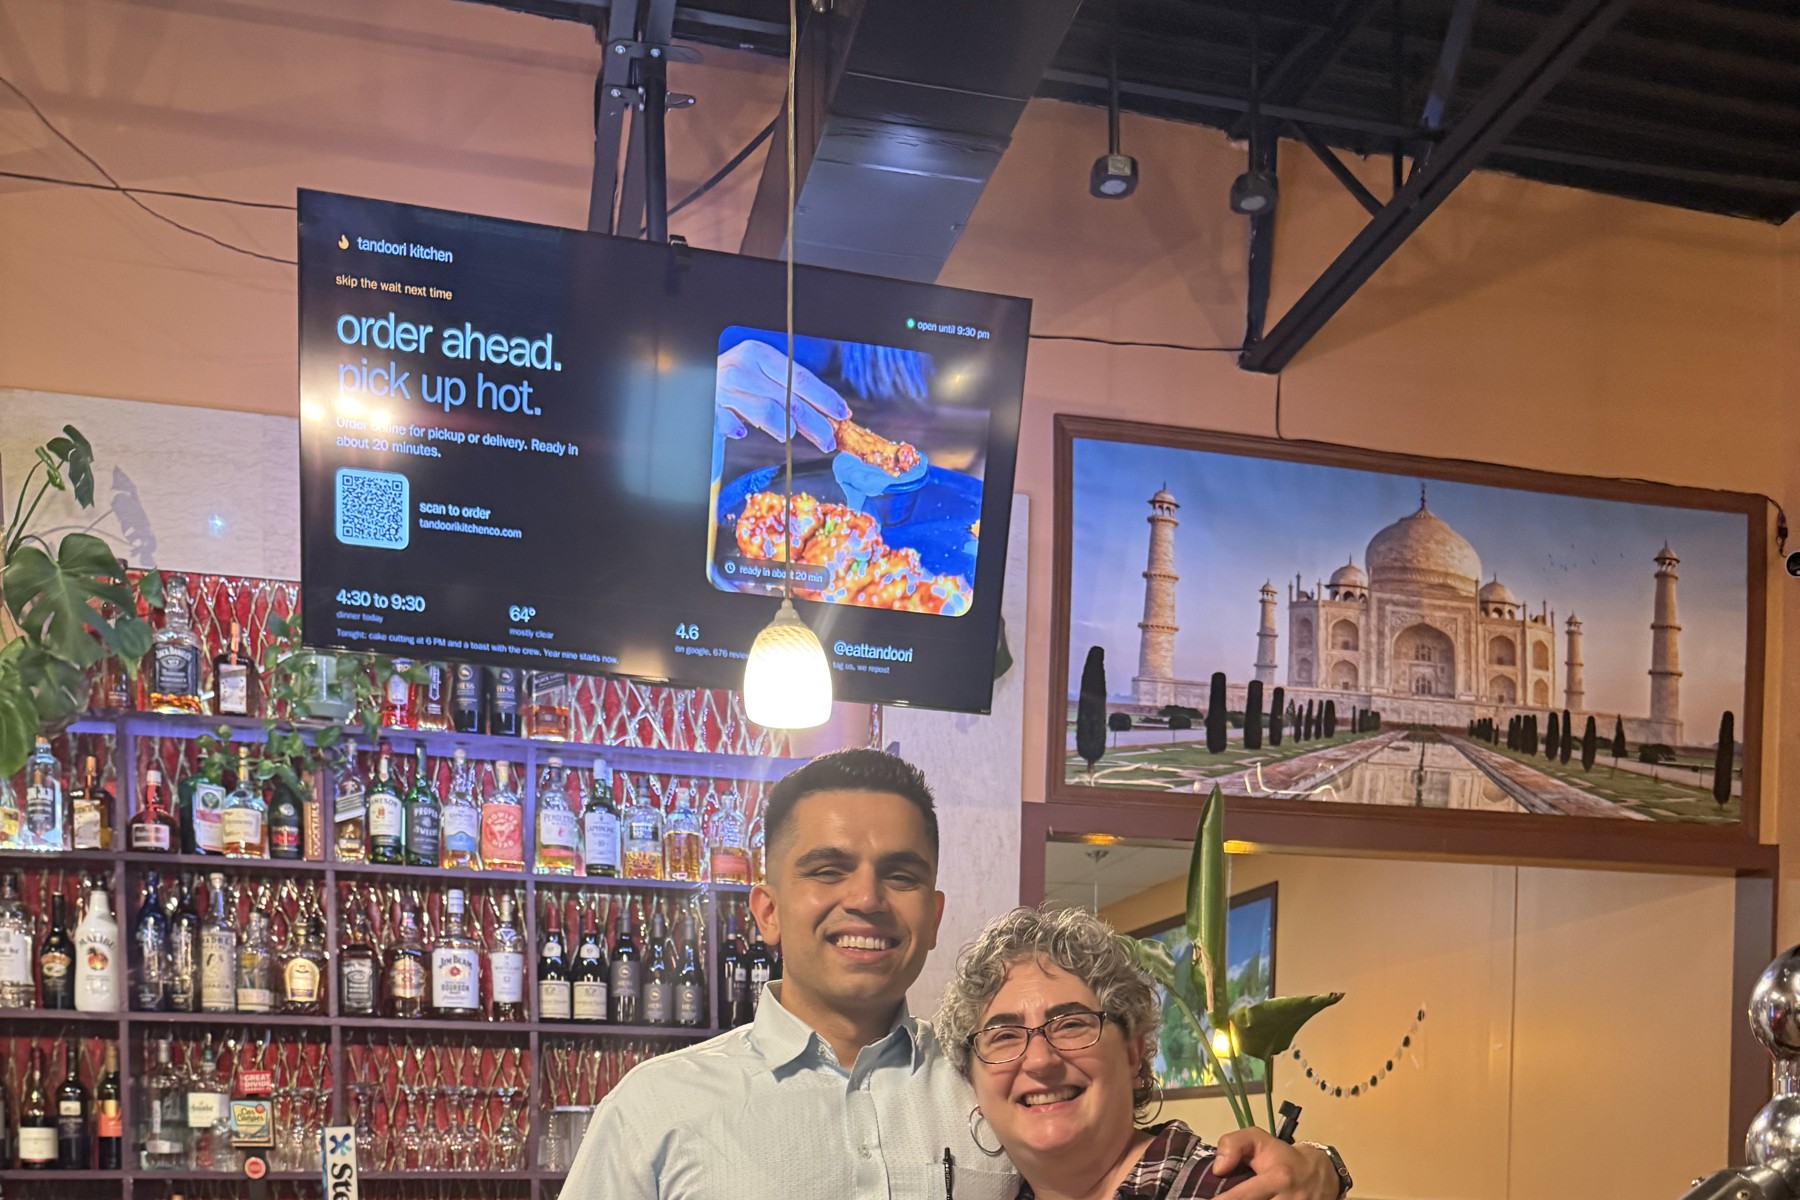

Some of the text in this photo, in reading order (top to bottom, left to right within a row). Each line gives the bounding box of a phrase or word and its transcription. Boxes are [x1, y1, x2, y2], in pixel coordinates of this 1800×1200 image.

[357, 236, 453, 264] tandoori kitchen
[335, 274, 453, 301] skip the wait next time
[917, 321, 990, 339] open until 9:30 pm
[336, 311, 562, 372] order ahead.
[337, 357, 542, 416] pick up hot.
[336, 416, 367, 430] Order
[409, 423, 425, 438] for
[427, 426, 465, 444] pickup
[467, 432, 480, 444] or
[482, 432, 528, 451] delivery.
[530, 438, 566, 456] Ready
[568, 442, 579, 456] in
[336, 434, 441, 458] about 20 minutes.
[419, 501, 491, 520] scan to order
[419, 517, 522, 539] tandoorikitchenco.com
[739, 565, 824, 583] ready in abot 20 min
[336, 588, 426, 613] 4:30 to 9:30
[336, 610, 384, 624] dinner today
[509, 604, 536, 623] 64°
[509, 627, 554, 640] mostly clear
[674, 622, 700, 640] 4.6
[336, 628, 367, 640] Tonight:
[368, 631, 387, 641] cake
[388, 633, 415, 645] cutting
[416, 636, 425, 645] at
[425, 637, 432, 646] 6
[433, 637, 446, 647] PM
[447, 639, 462, 648] and
[470, 640, 489, 651] toast
[490, 642, 507, 652] with
[508, 643, 521, 653] the
[522, 645, 542, 656] crew.
[543, 648, 561, 658] Year
[561, 651, 578, 660] nine
[578, 652, 600, 663] starts
[601, 655, 620, 665] now.
[675, 646, 685, 654] on
[713, 648, 728, 658] 676
[833, 639, 913, 663] @eattandoori
[833, 661, 844, 671] tag
[857, 664, 867, 672] we
[868, 665, 890, 674] repost
[439, 955, 473, 969] JIM BEAM
